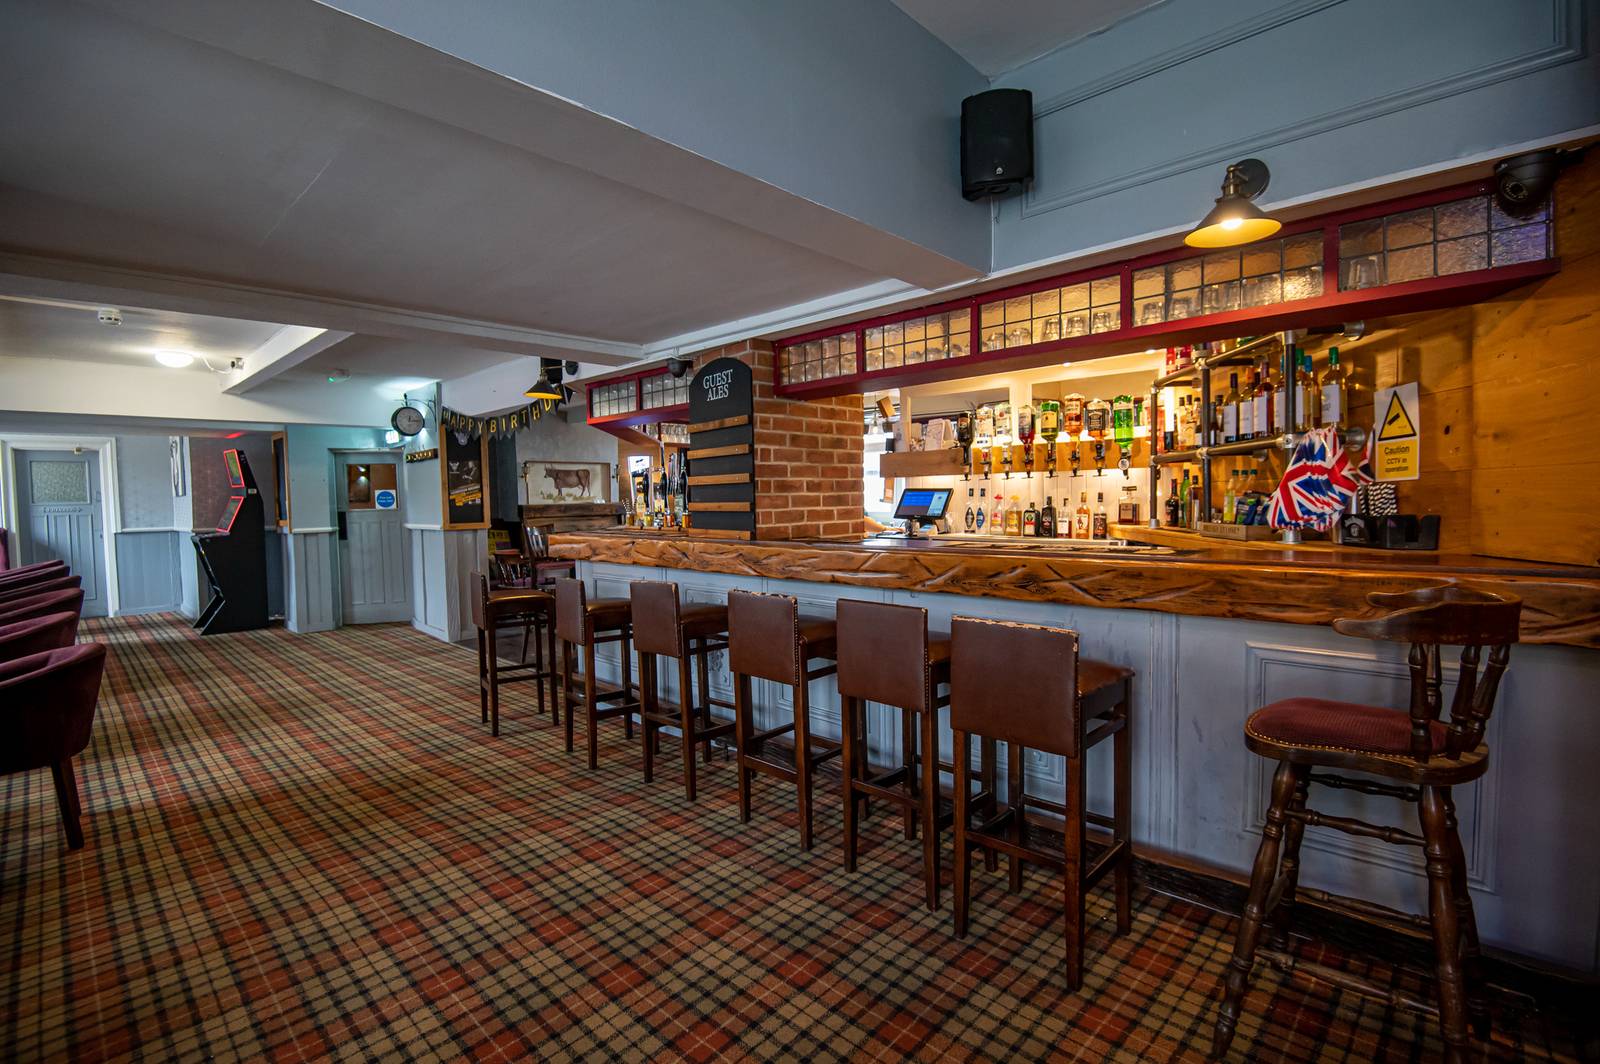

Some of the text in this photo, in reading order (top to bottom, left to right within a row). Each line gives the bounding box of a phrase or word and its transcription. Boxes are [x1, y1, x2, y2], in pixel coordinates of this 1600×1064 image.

[703, 369, 733, 389] GUEST
[706, 384, 729, 402] ALES
[443, 397, 556, 433] HAPPY BIRTHD
[1384, 445, 1410, 455] Caution
[1386, 457, 1401, 465] CCTV
